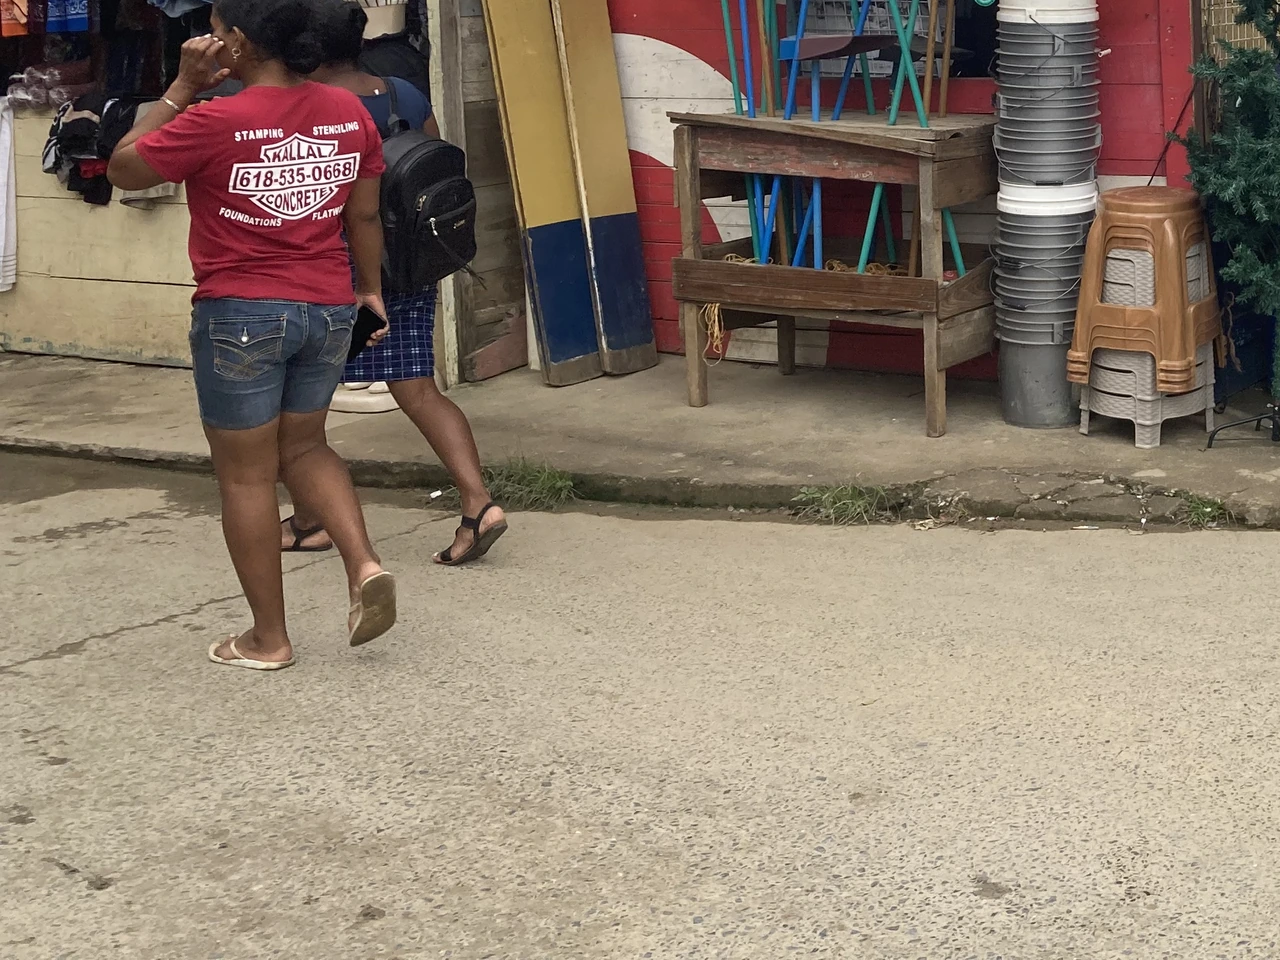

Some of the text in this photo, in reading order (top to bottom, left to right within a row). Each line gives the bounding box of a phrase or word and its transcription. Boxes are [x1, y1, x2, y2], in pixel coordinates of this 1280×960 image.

[235, 121, 359, 141] STAMPING STENCILING
[272, 141, 328, 163] KALLAL
[239, 161, 352, 188] 618-535-0668
[265, 186, 331, 212] CONCRETE
[218, 207, 282, 227] FOUNDATIONS
